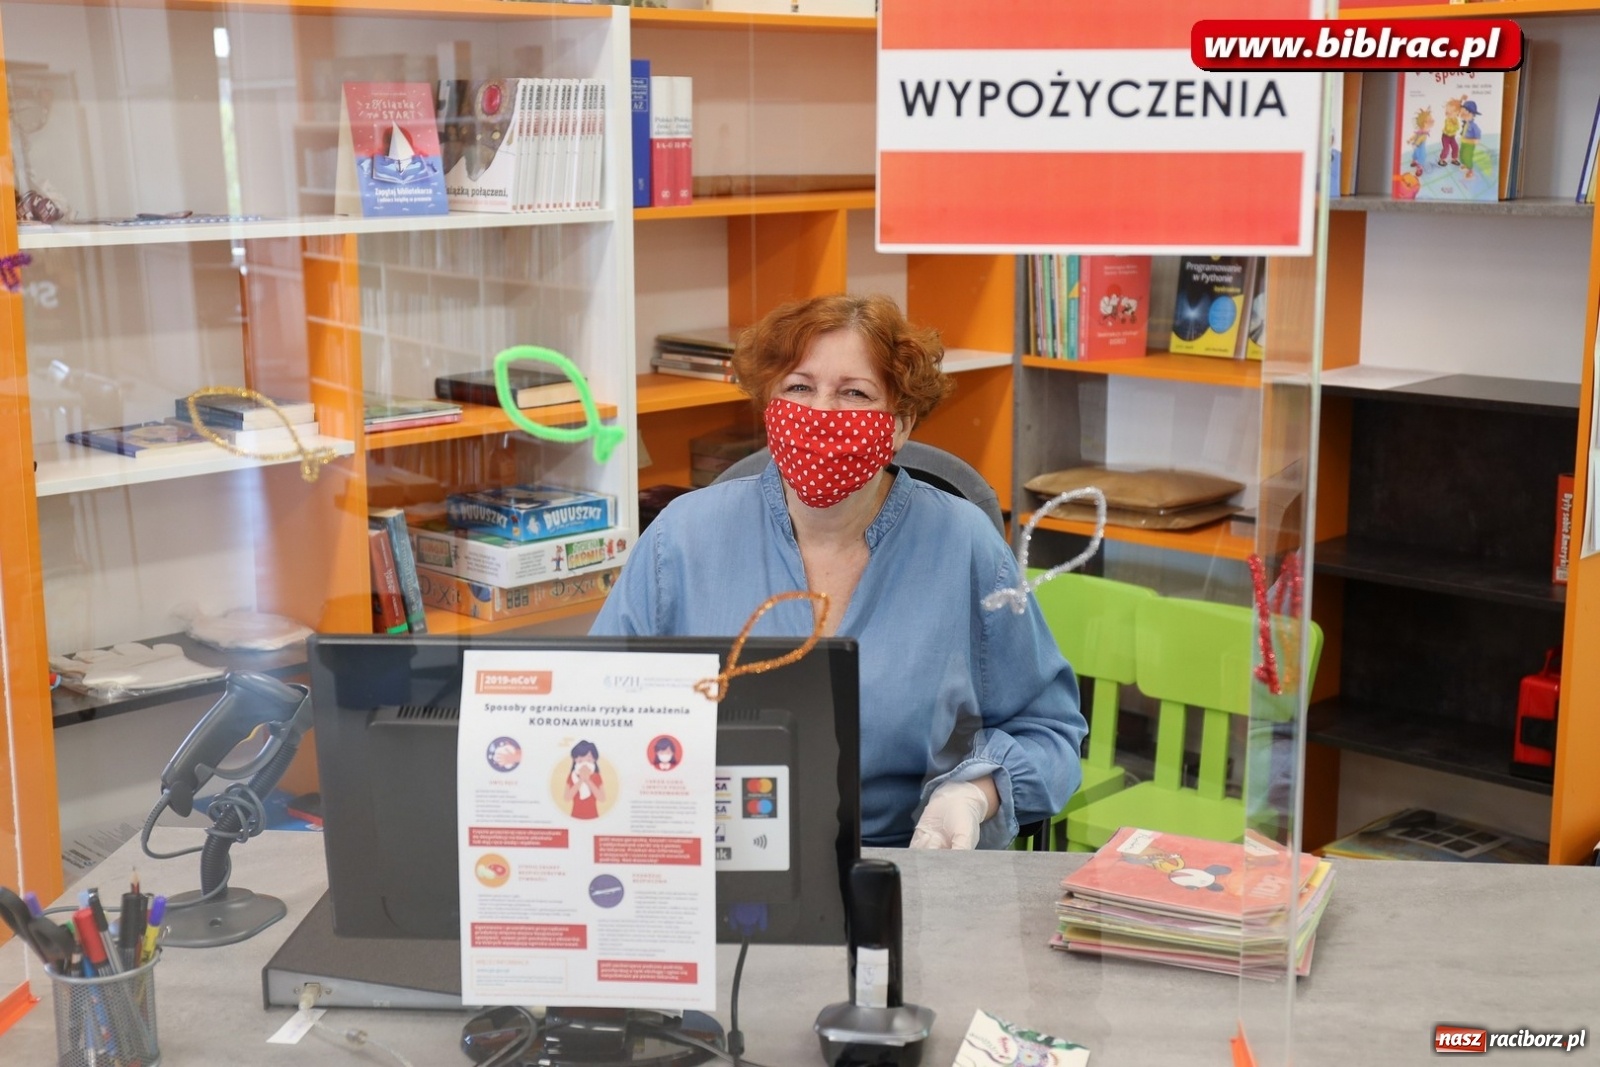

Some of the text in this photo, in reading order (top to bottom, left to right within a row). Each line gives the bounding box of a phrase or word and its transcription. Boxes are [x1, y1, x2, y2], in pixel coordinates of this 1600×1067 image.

[899, 69, 1287, 119] WYPOŻYCZENIA
[382, 111, 416, 119] START
[1186, 262, 1242, 273] Programowanie
[1201, 273, 1233, 284] Pythonie
[1561, 493, 1573, 511] Były
[461, 503, 508, 528] DUUUSZKI
[543, 505, 602, 530] DUUUSZKI
[1562, 513, 1571, 534] sobie
[484, 675, 538, 685] 2019-nCoV
[484, 703, 690, 715] Sposoby ograniczania ryzyka zakażenia
[529, 718, 633, 728] KORONAWIRUSEM
